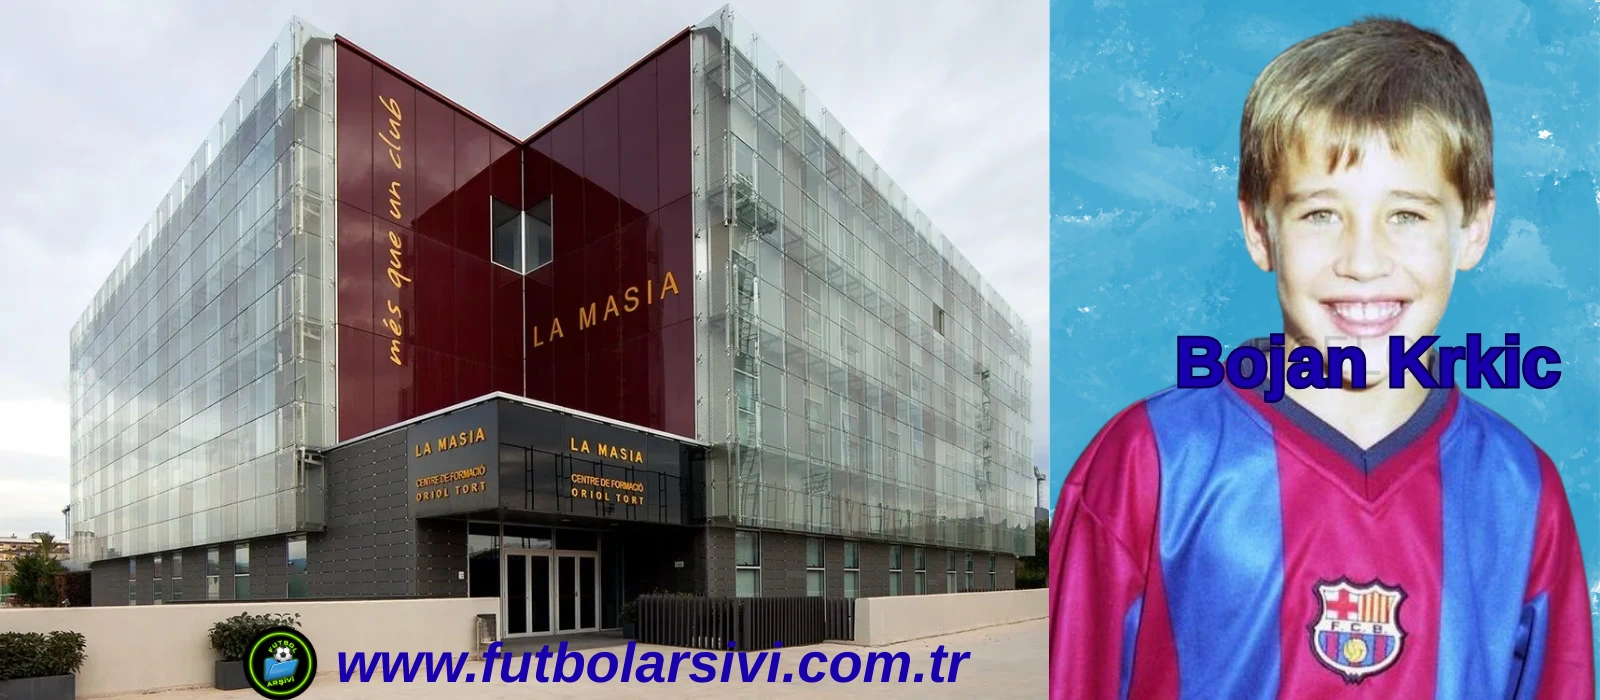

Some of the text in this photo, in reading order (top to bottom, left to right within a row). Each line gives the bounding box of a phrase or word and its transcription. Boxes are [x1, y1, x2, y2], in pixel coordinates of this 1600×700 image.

[378, 94, 412, 366] més que un club
[533, 271, 680, 348] LA MASIA
[415, 427, 486, 457] LA MASIA
[570, 437, 643, 464] LA MASIA
[416, 464, 487, 488] CENTRE DE FORMACIÓ
[571, 473, 644, 493] CENTRE DE FORMACIÓ
[416, 481, 487, 502] ORIOL TORT
[571, 487, 644, 505] ORIOL TORT
